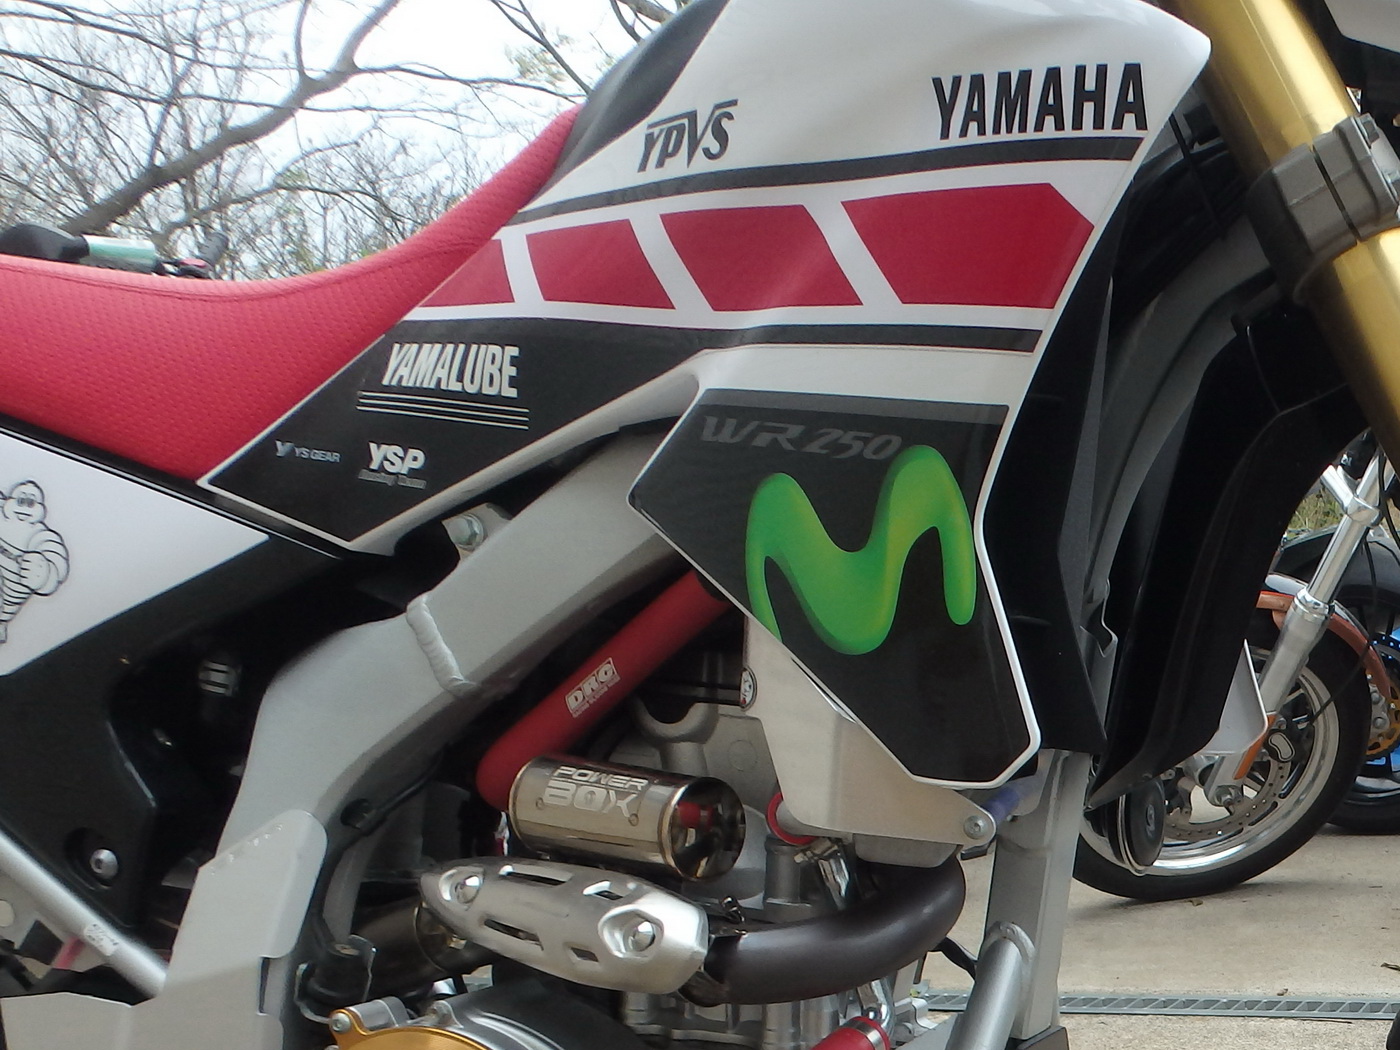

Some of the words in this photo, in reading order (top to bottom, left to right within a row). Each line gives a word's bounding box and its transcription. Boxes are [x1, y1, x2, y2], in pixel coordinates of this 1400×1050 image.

[931, 62, 1149, 140] YAMAHA
[637, 98, 740, 173] YPVS
[382, 342, 520, 399] YAMALUBE
[368, 441, 426, 475] YSP
[567, 663, 614, 711] DRC
[543, 779, 638, 818] BOX
[553, 765, 649, 791] POWER
